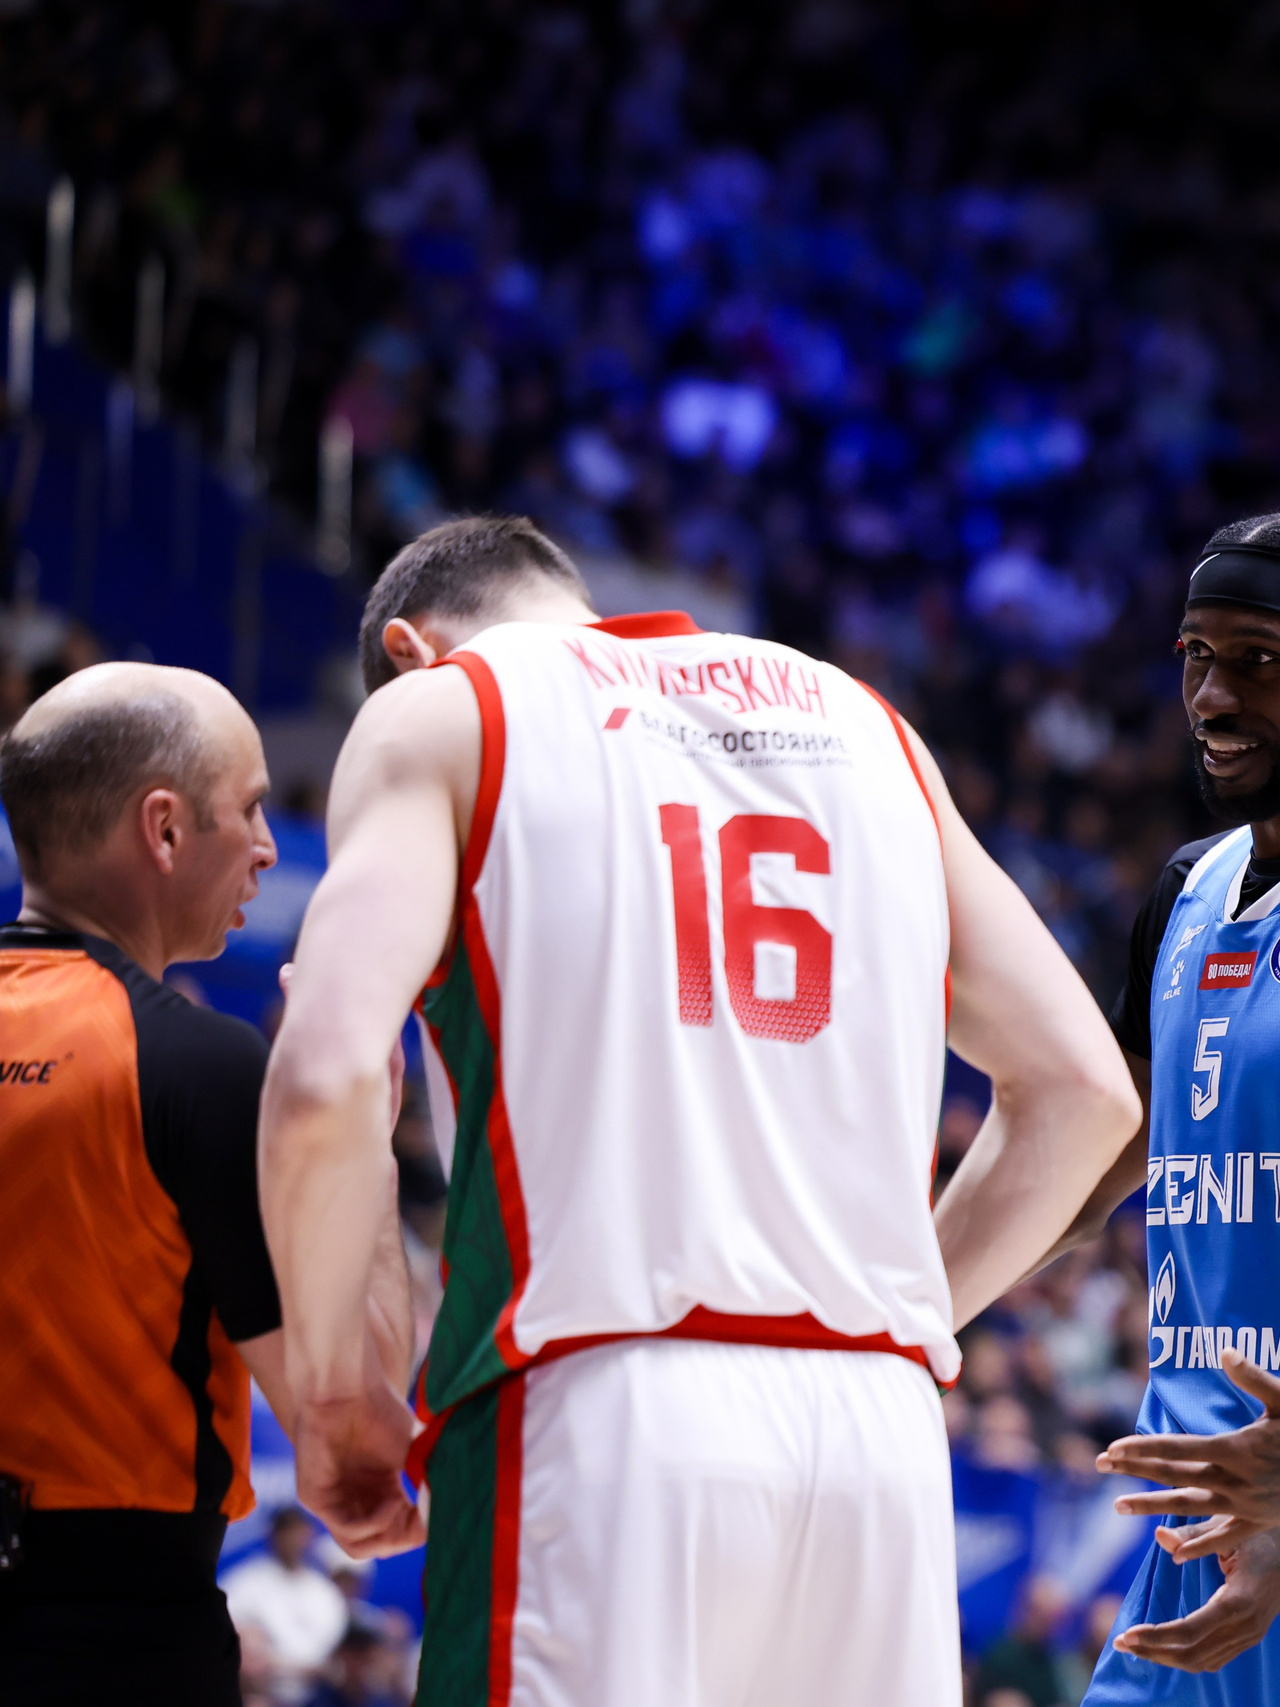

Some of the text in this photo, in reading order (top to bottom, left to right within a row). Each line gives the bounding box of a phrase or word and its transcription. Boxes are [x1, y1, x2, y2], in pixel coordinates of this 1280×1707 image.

[658, 803, 833, 1044] 16
[1217, 963, 1252, 978] ПОБЕДА!
[1191, 1017, 1230, 1121] 5
